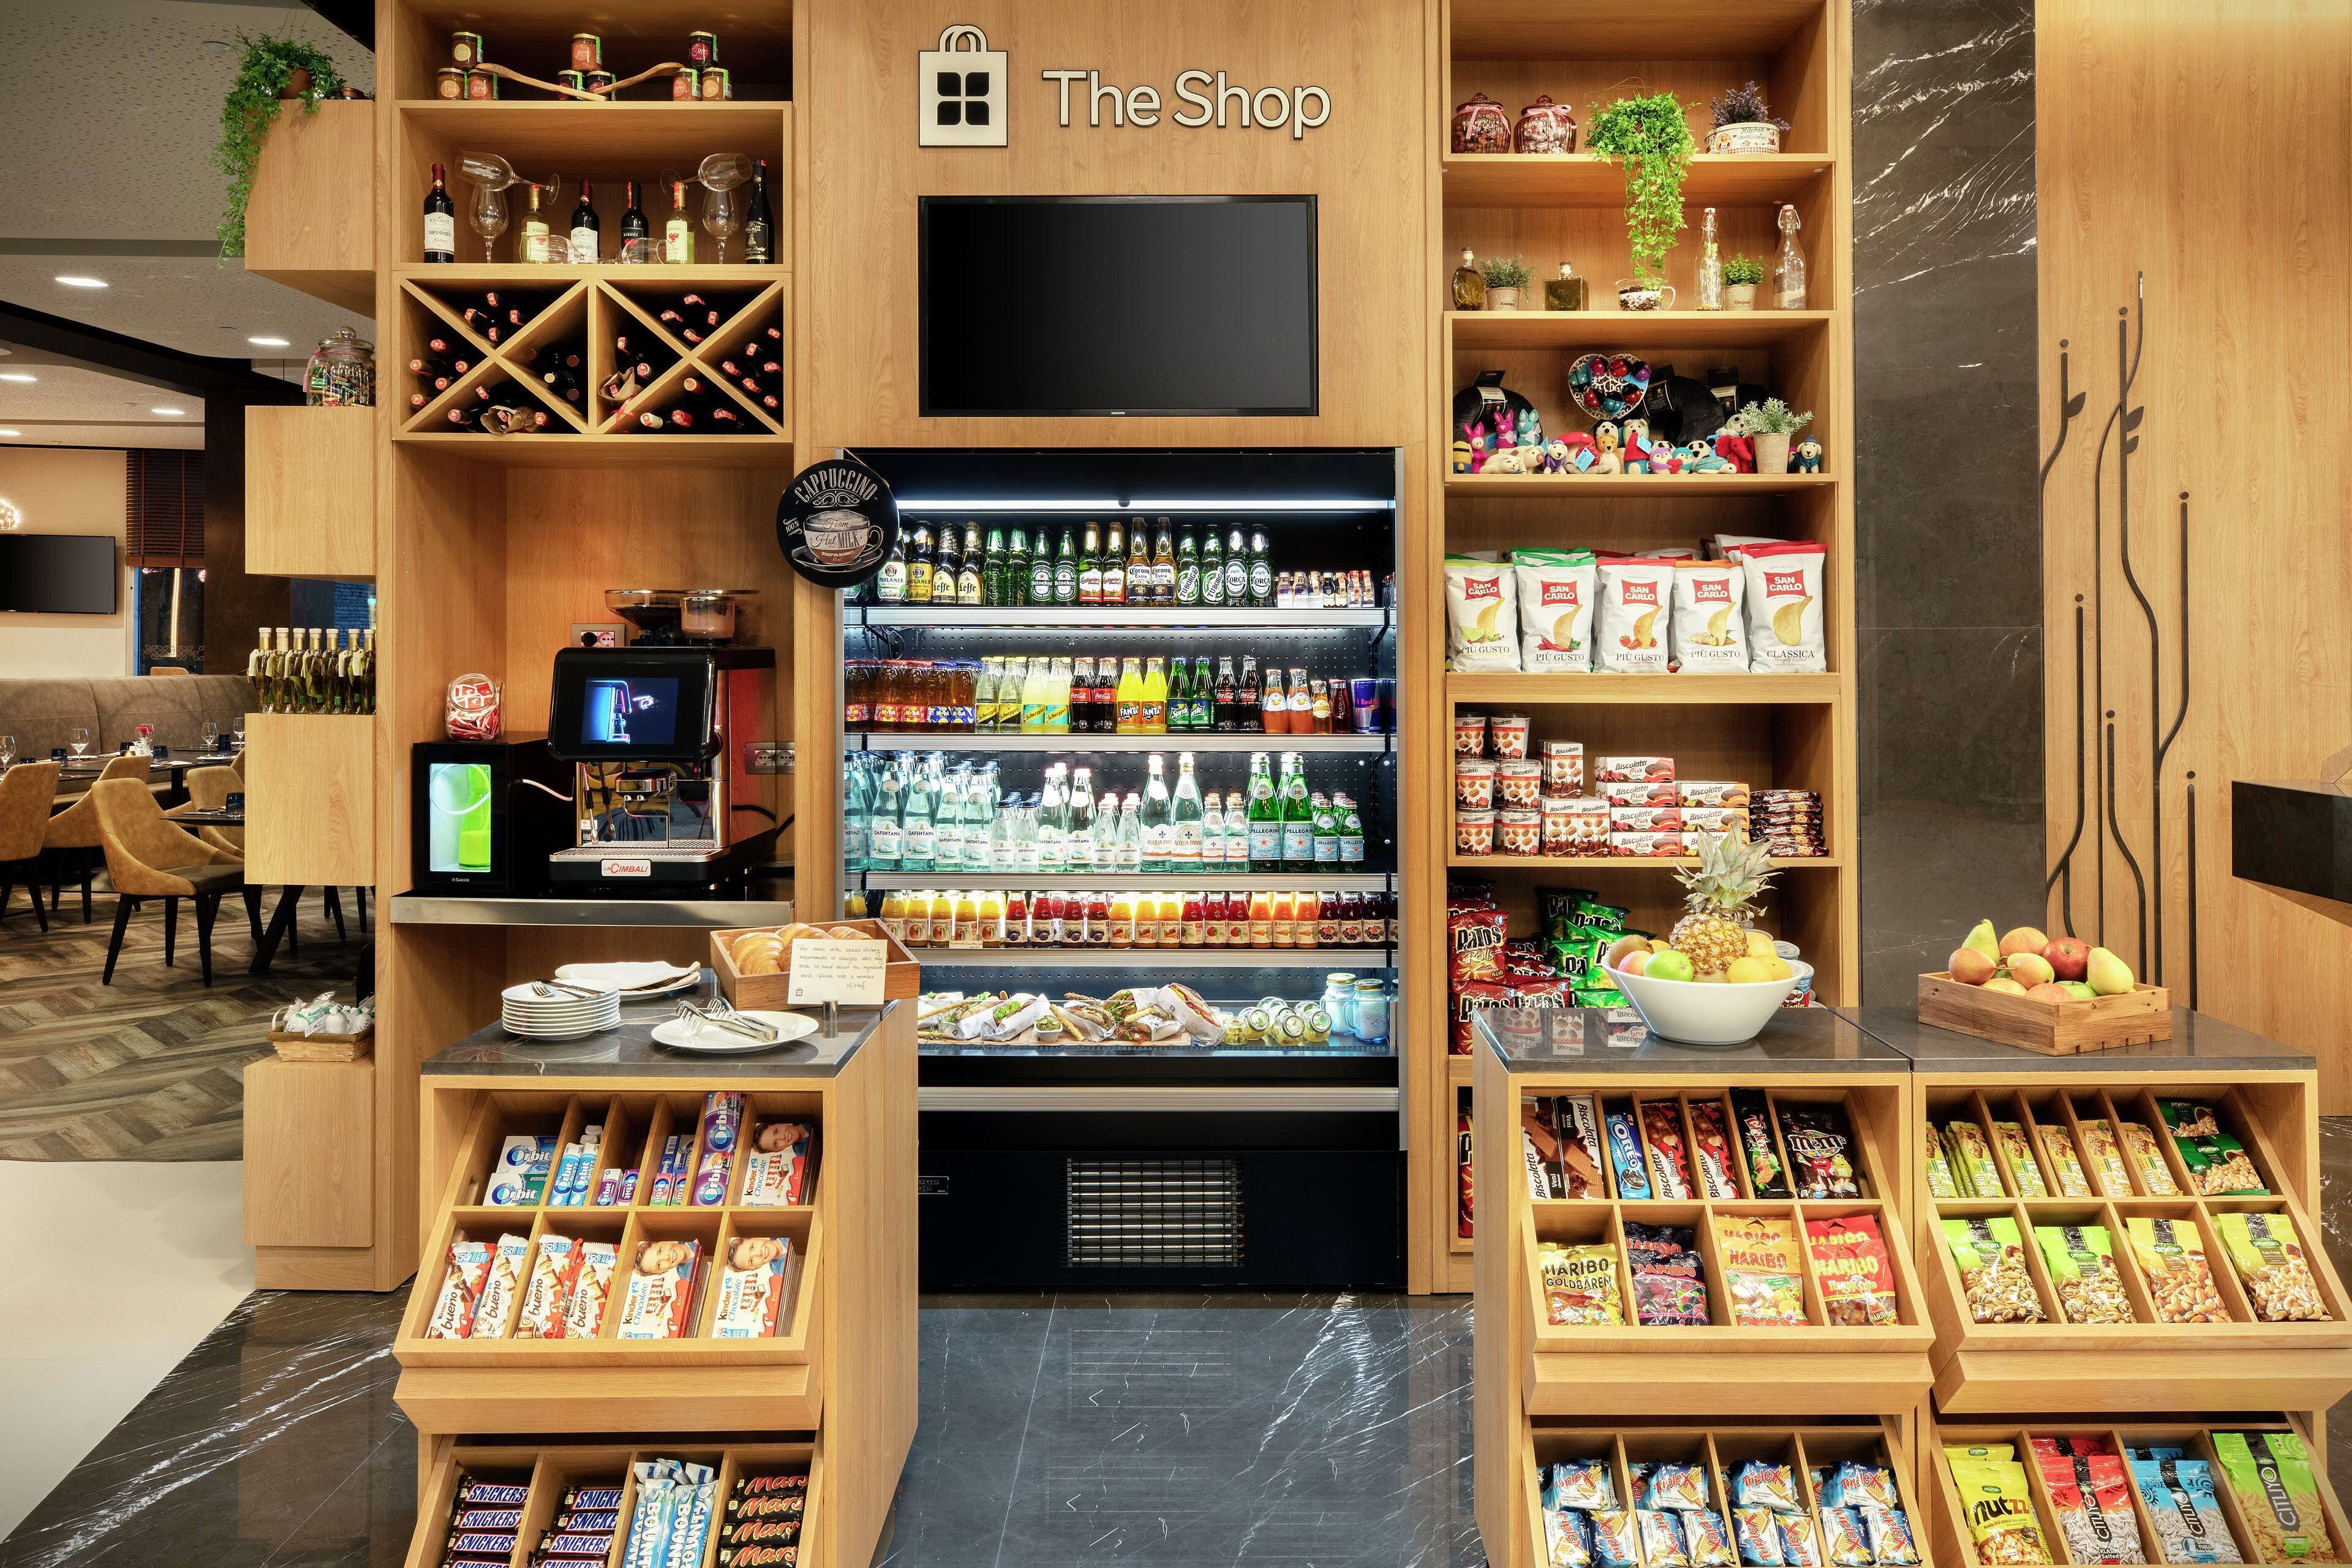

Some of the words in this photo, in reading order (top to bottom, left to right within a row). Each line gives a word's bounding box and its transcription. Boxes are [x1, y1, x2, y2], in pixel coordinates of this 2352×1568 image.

[1042, 69, 1161, 127] The
[1172, 69, 1331, 140] Shop
[794, 468, 878, 503] CAPPUCCINO
[785, 521, 801, 533] 100%
[823, 518, 850, 530] Foam
[810, 533, 837, 547] Hot
[838, 530, 861, 549] MILK
[933, 582, 950, 592] Leffe
[959, 582, 976, 592] Leffe
[1180, 572, 1196, 598] TUBORG
[1207, 572, 1223, 598] TUBORG
[1226, 575, 1246, 584] KORÇA
[1468, 587, 1498, 595] CARLO
[1616, 652, 1632, 661] PIÙ
[1691, 649, 1706, 658] PIÙ
[1615, 760, 1647, 771] Biscolata
[1616, 785, 1649, 796] Biscolata
[1690, 786, 1722, 796] Biscolata
[1550, 804, 1574, 813] Biscolata
[1581, 804, 1605, 813] Biscolata
[1619, 810, 1653, 821] Biscolata
[1689, 810, 1722, 821] Biscolata
[1621, 834, 1654, 845] Biscolata
[609, 863, 648, 873] CIMBALI
[863, 947, 882, 957] dietary
[1463, 950, 1495, 963] Rolls
[1613, 1123, 1639, 1167] OREO
[507, 1144, 551, 1167] Orbit
[492, 1183, 538, 1205] Orbit
[1728, 1249, 1788, 1268] HARIBO
[1545, 1258, 1609, 1276] HARIBO
[1633, 1263, 1696, 1277] HARIBO
[1546, 1276, 1612, 1290] GOLDBÄREN
[528, 1278, 544, 1316] bueno
[633, 1283, 649, 1326] Chocolate
[729, 1279, 742, 1322] Chocolate
[573, 1289, 589, 1328] bueno
[745, 1475, 809, 1495] Mars
[469, 1485, 529, 1502] SNICKERS
[737, 1496, 804, 1519] Mars
[1975, 1496, 2029, 1526] nutzz
[462, 1511, 521, 1527] SNICKERS
[731, 1520, 800, 1544] Mars
[456, 1534, 515, 1551] SNICKERS
[551, 1536, 611, 1553] SNICKERS
[729, 1546, 799, 1568] Mars
